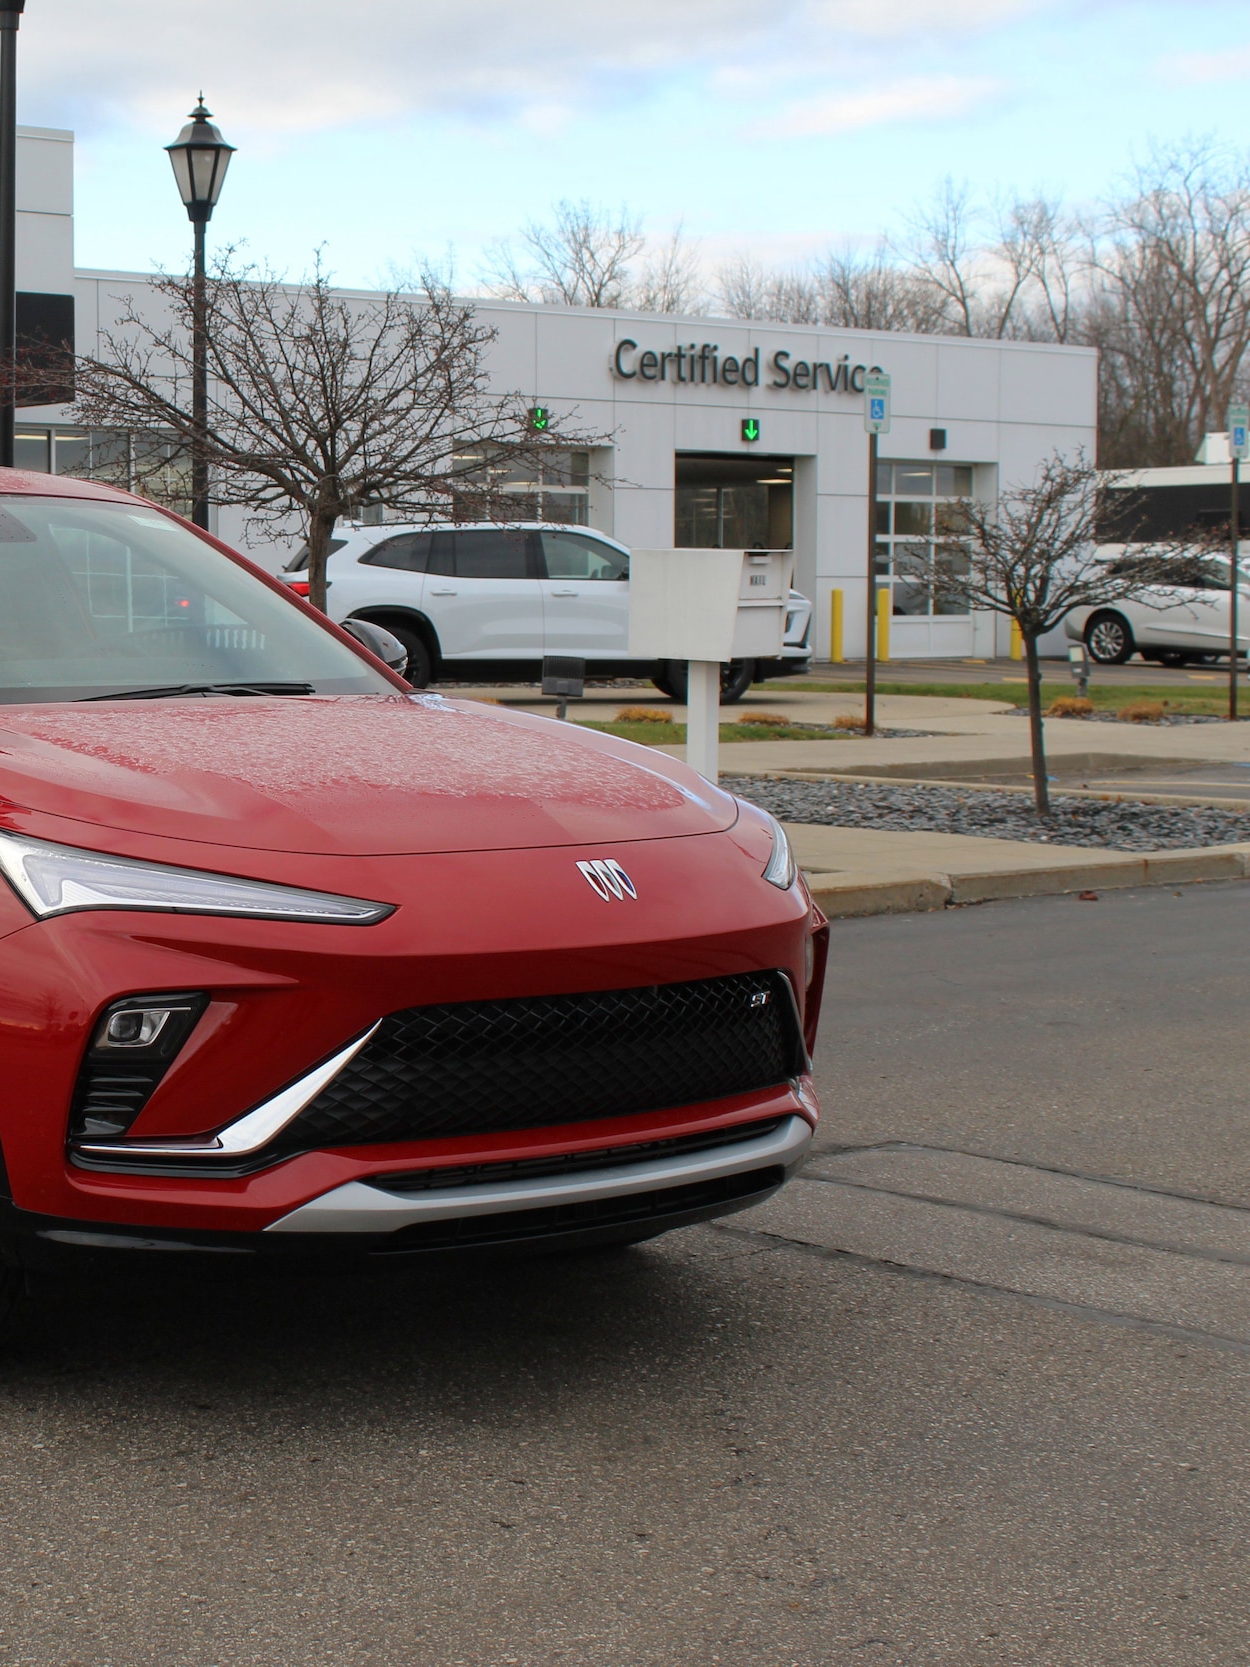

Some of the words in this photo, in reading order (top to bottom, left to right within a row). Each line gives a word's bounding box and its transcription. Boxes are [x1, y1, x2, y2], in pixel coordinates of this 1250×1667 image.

[614, 338, 760, 387] Certified
[772, 350, 884, 393] Servic
[750, 575, 766, 586] MAIL
